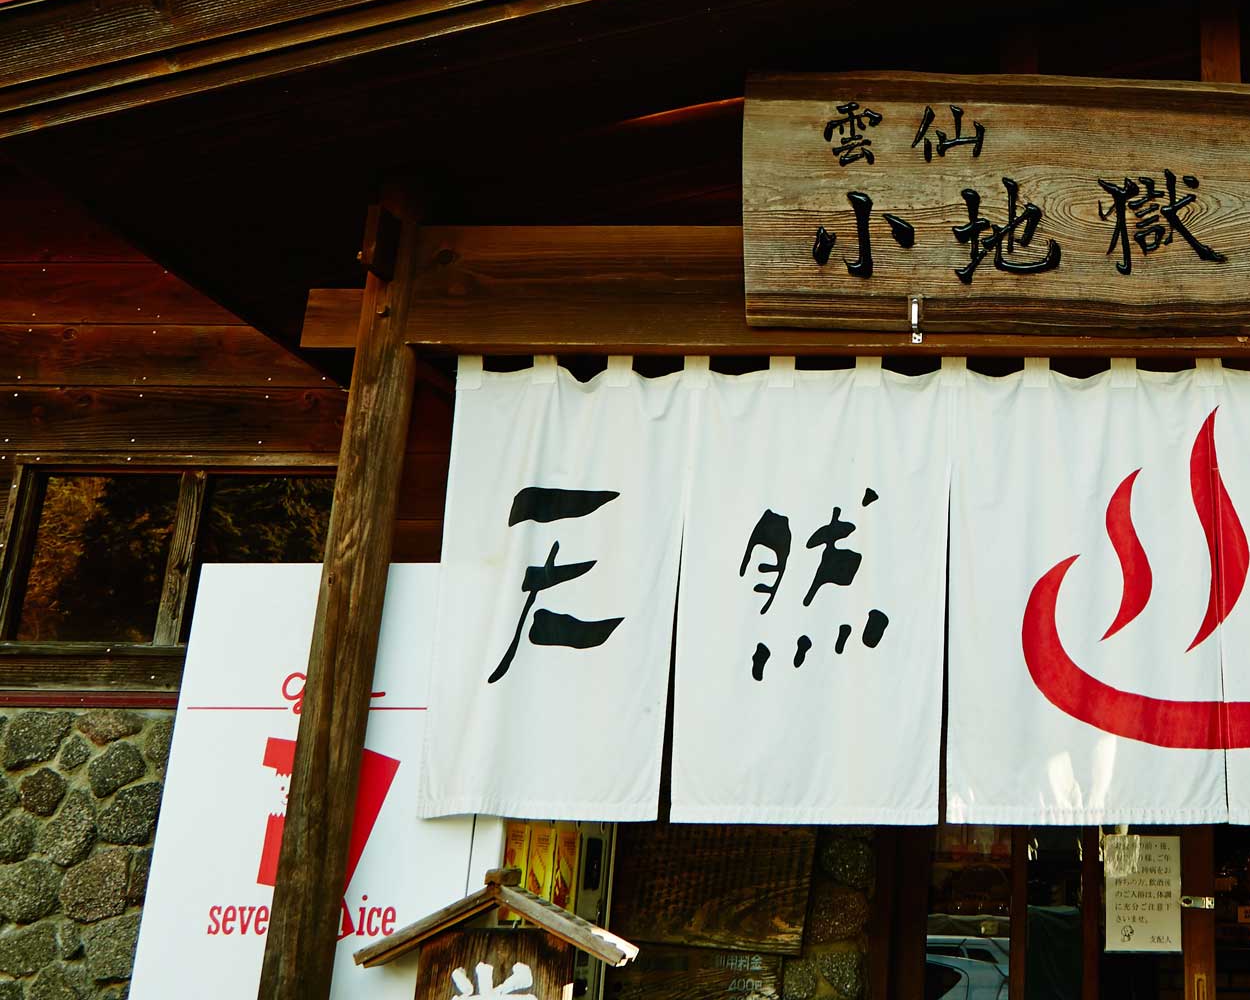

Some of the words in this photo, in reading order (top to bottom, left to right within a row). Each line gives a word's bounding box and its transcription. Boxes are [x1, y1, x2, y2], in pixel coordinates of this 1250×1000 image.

[824, 100, 986, 166] 雲仙
[487, 486, 890, 684] 天然
[355, 894, 397, 937] ice
